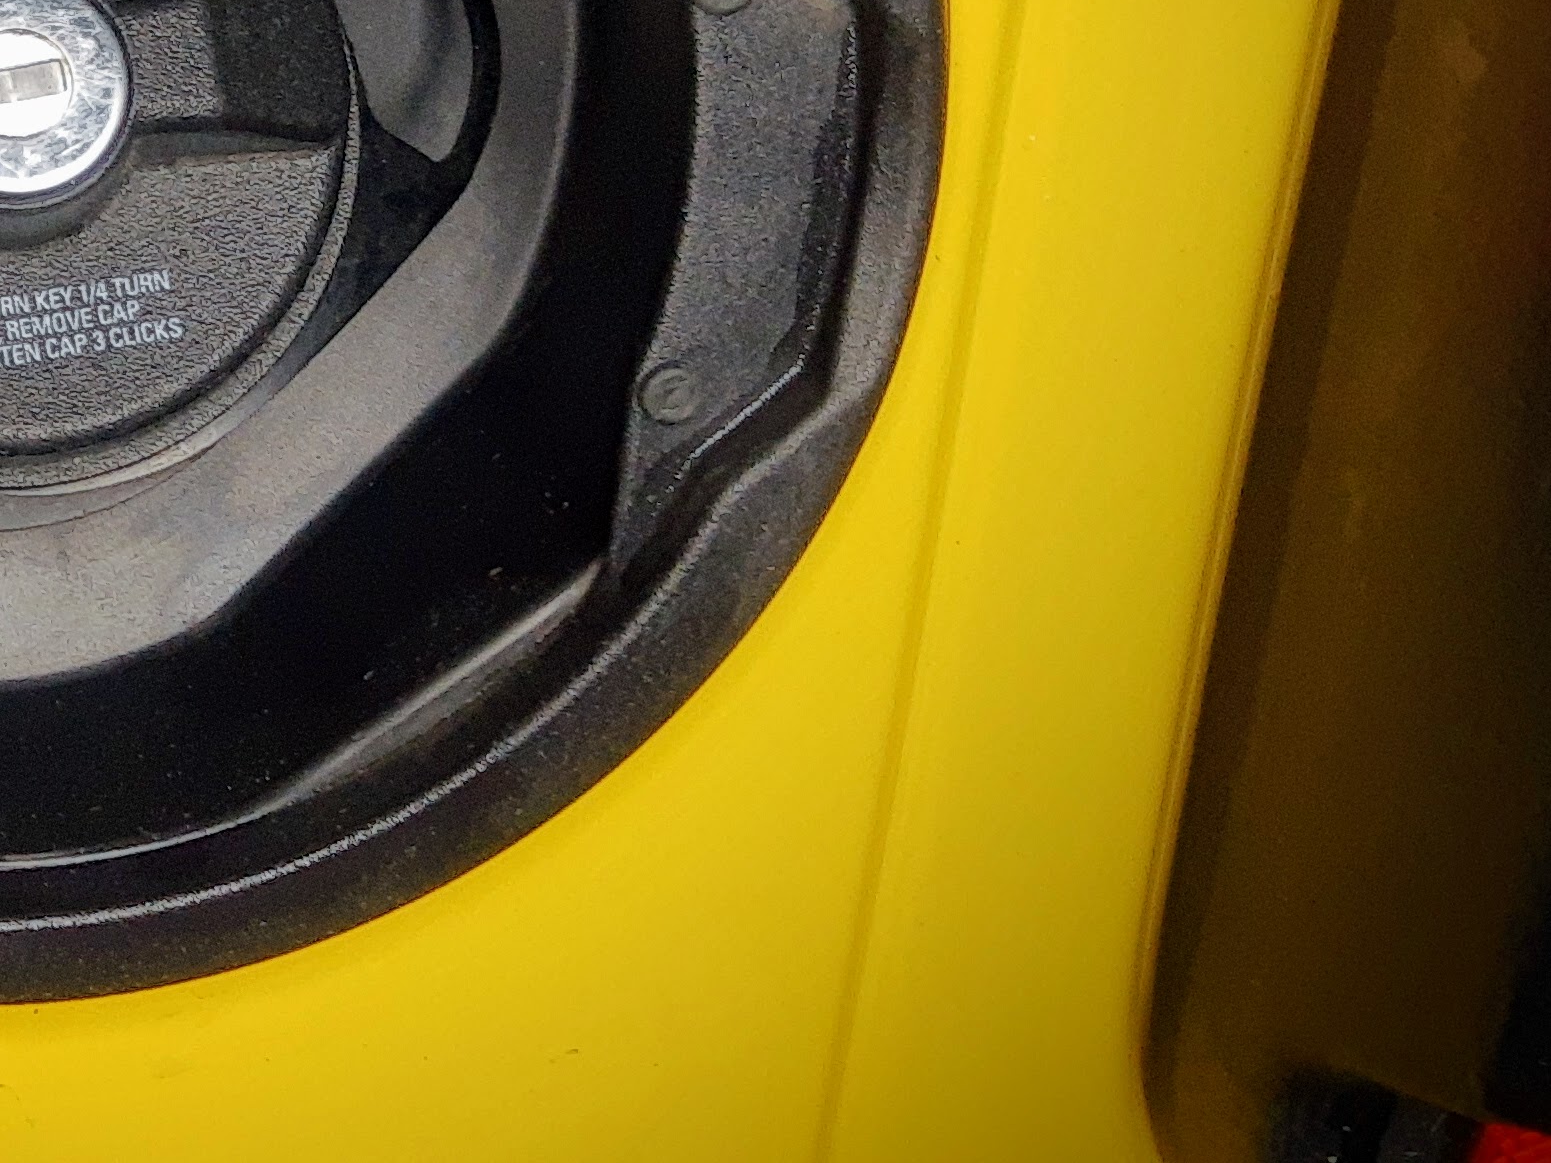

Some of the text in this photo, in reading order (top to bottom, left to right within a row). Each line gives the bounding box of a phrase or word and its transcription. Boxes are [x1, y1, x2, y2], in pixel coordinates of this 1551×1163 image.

[36, 286, 78, 311] KEY
[79, 280, 108, 306] 1/4
[110, 270, 171, 296] TURN
[6, 307, 93, 340] REMOVE
[98, 300, 141, 326] CAP
[45, 333, 88, 358] CAP
[92, 330, 105, 352] 3
[109, 316, 186, 347] CLICKS
